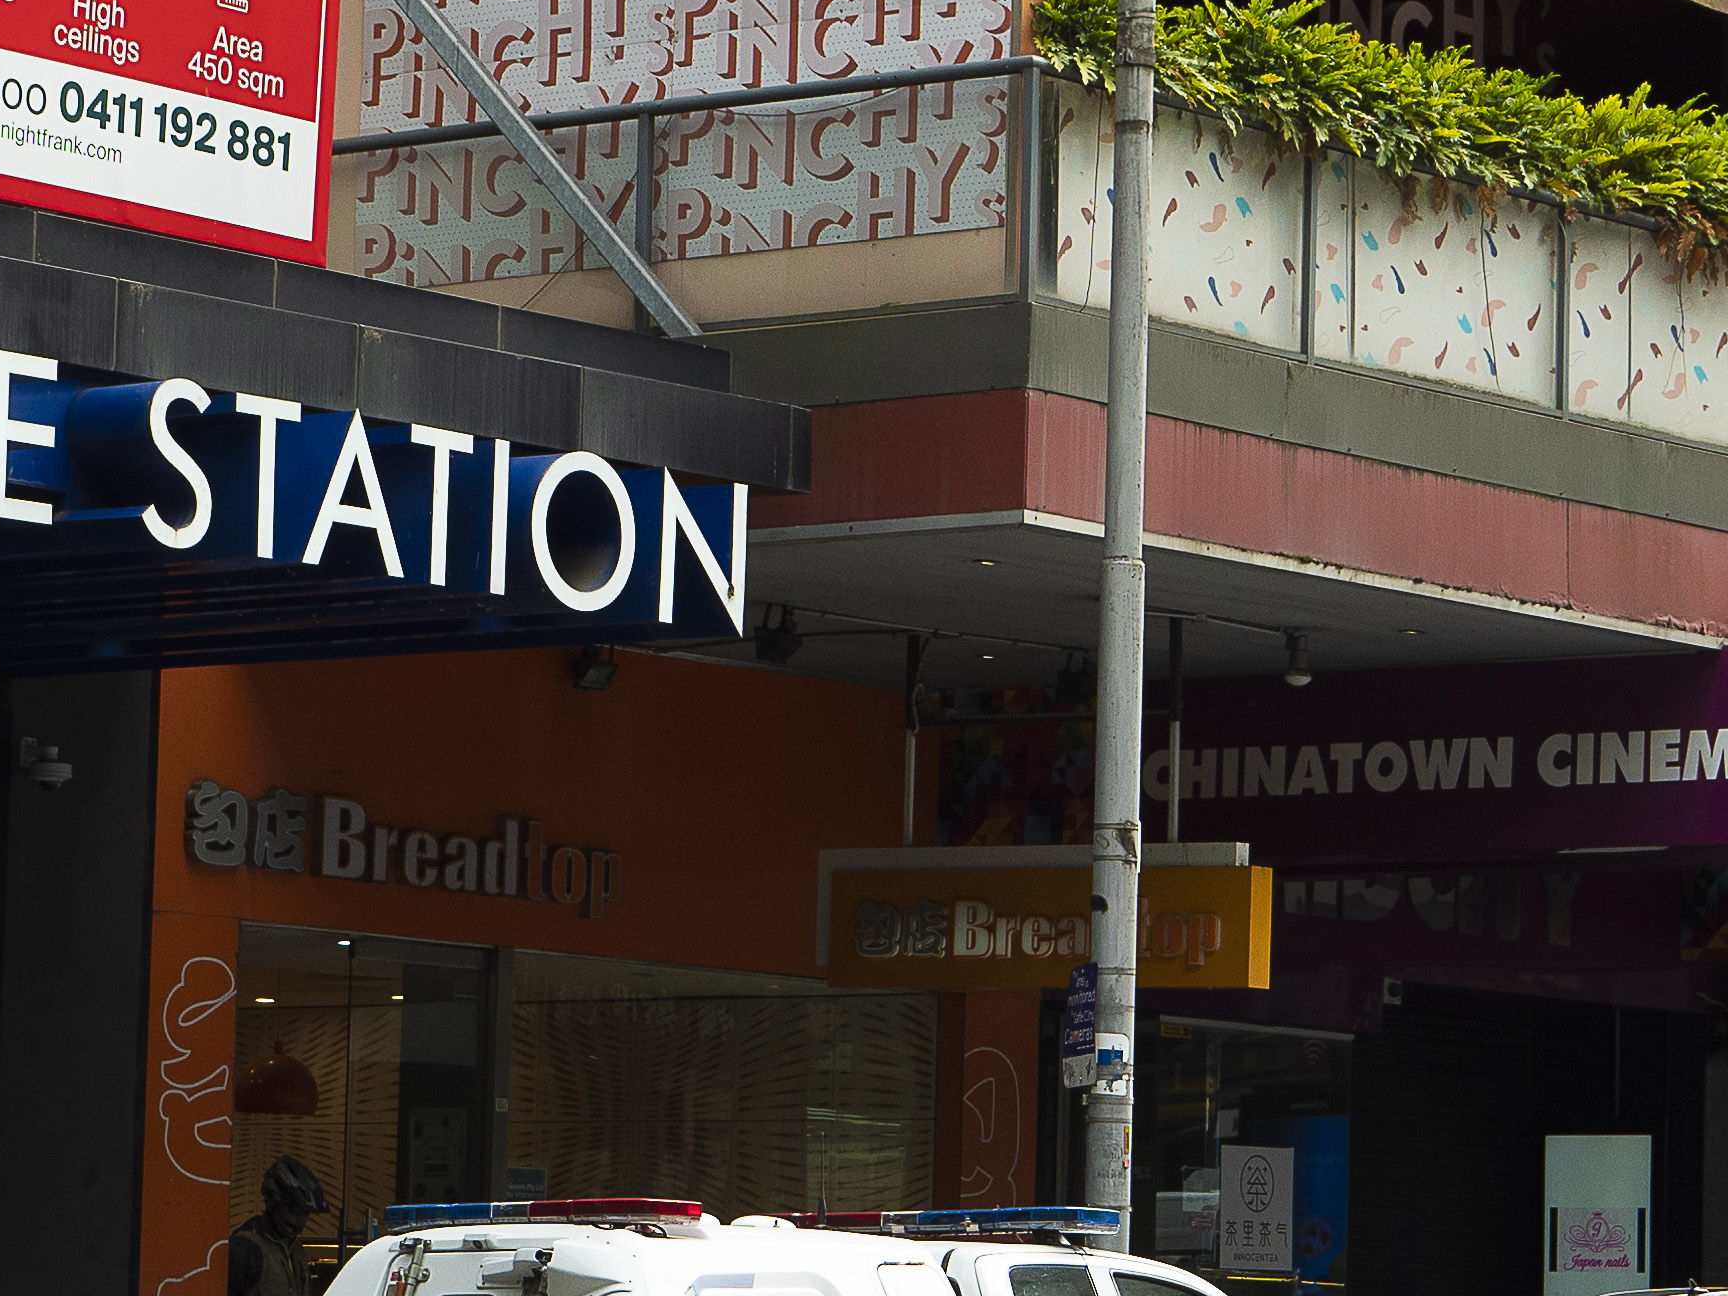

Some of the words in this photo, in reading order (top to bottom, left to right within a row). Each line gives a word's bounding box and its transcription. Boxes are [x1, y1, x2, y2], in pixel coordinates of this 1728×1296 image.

[53, 22, 141, 65] ceilings
[212, 25, 264, 62] Area
[187, 50, 233, 85] 450
[237, 67, 284, 99] sqm
[59, 80, 143, 138] 0411
[153, 100, 216, 155] 192
[226, 119, 292, 172] 881
[141, 376, 749, 638] STATION
[1141, 736, 1514, 802] CHINATOWN
[322, 796, 622, 919] Breadtop
[1563, 1253, 1604, 1273] Japan
[1604, 1254, 1631, 1269] nails
